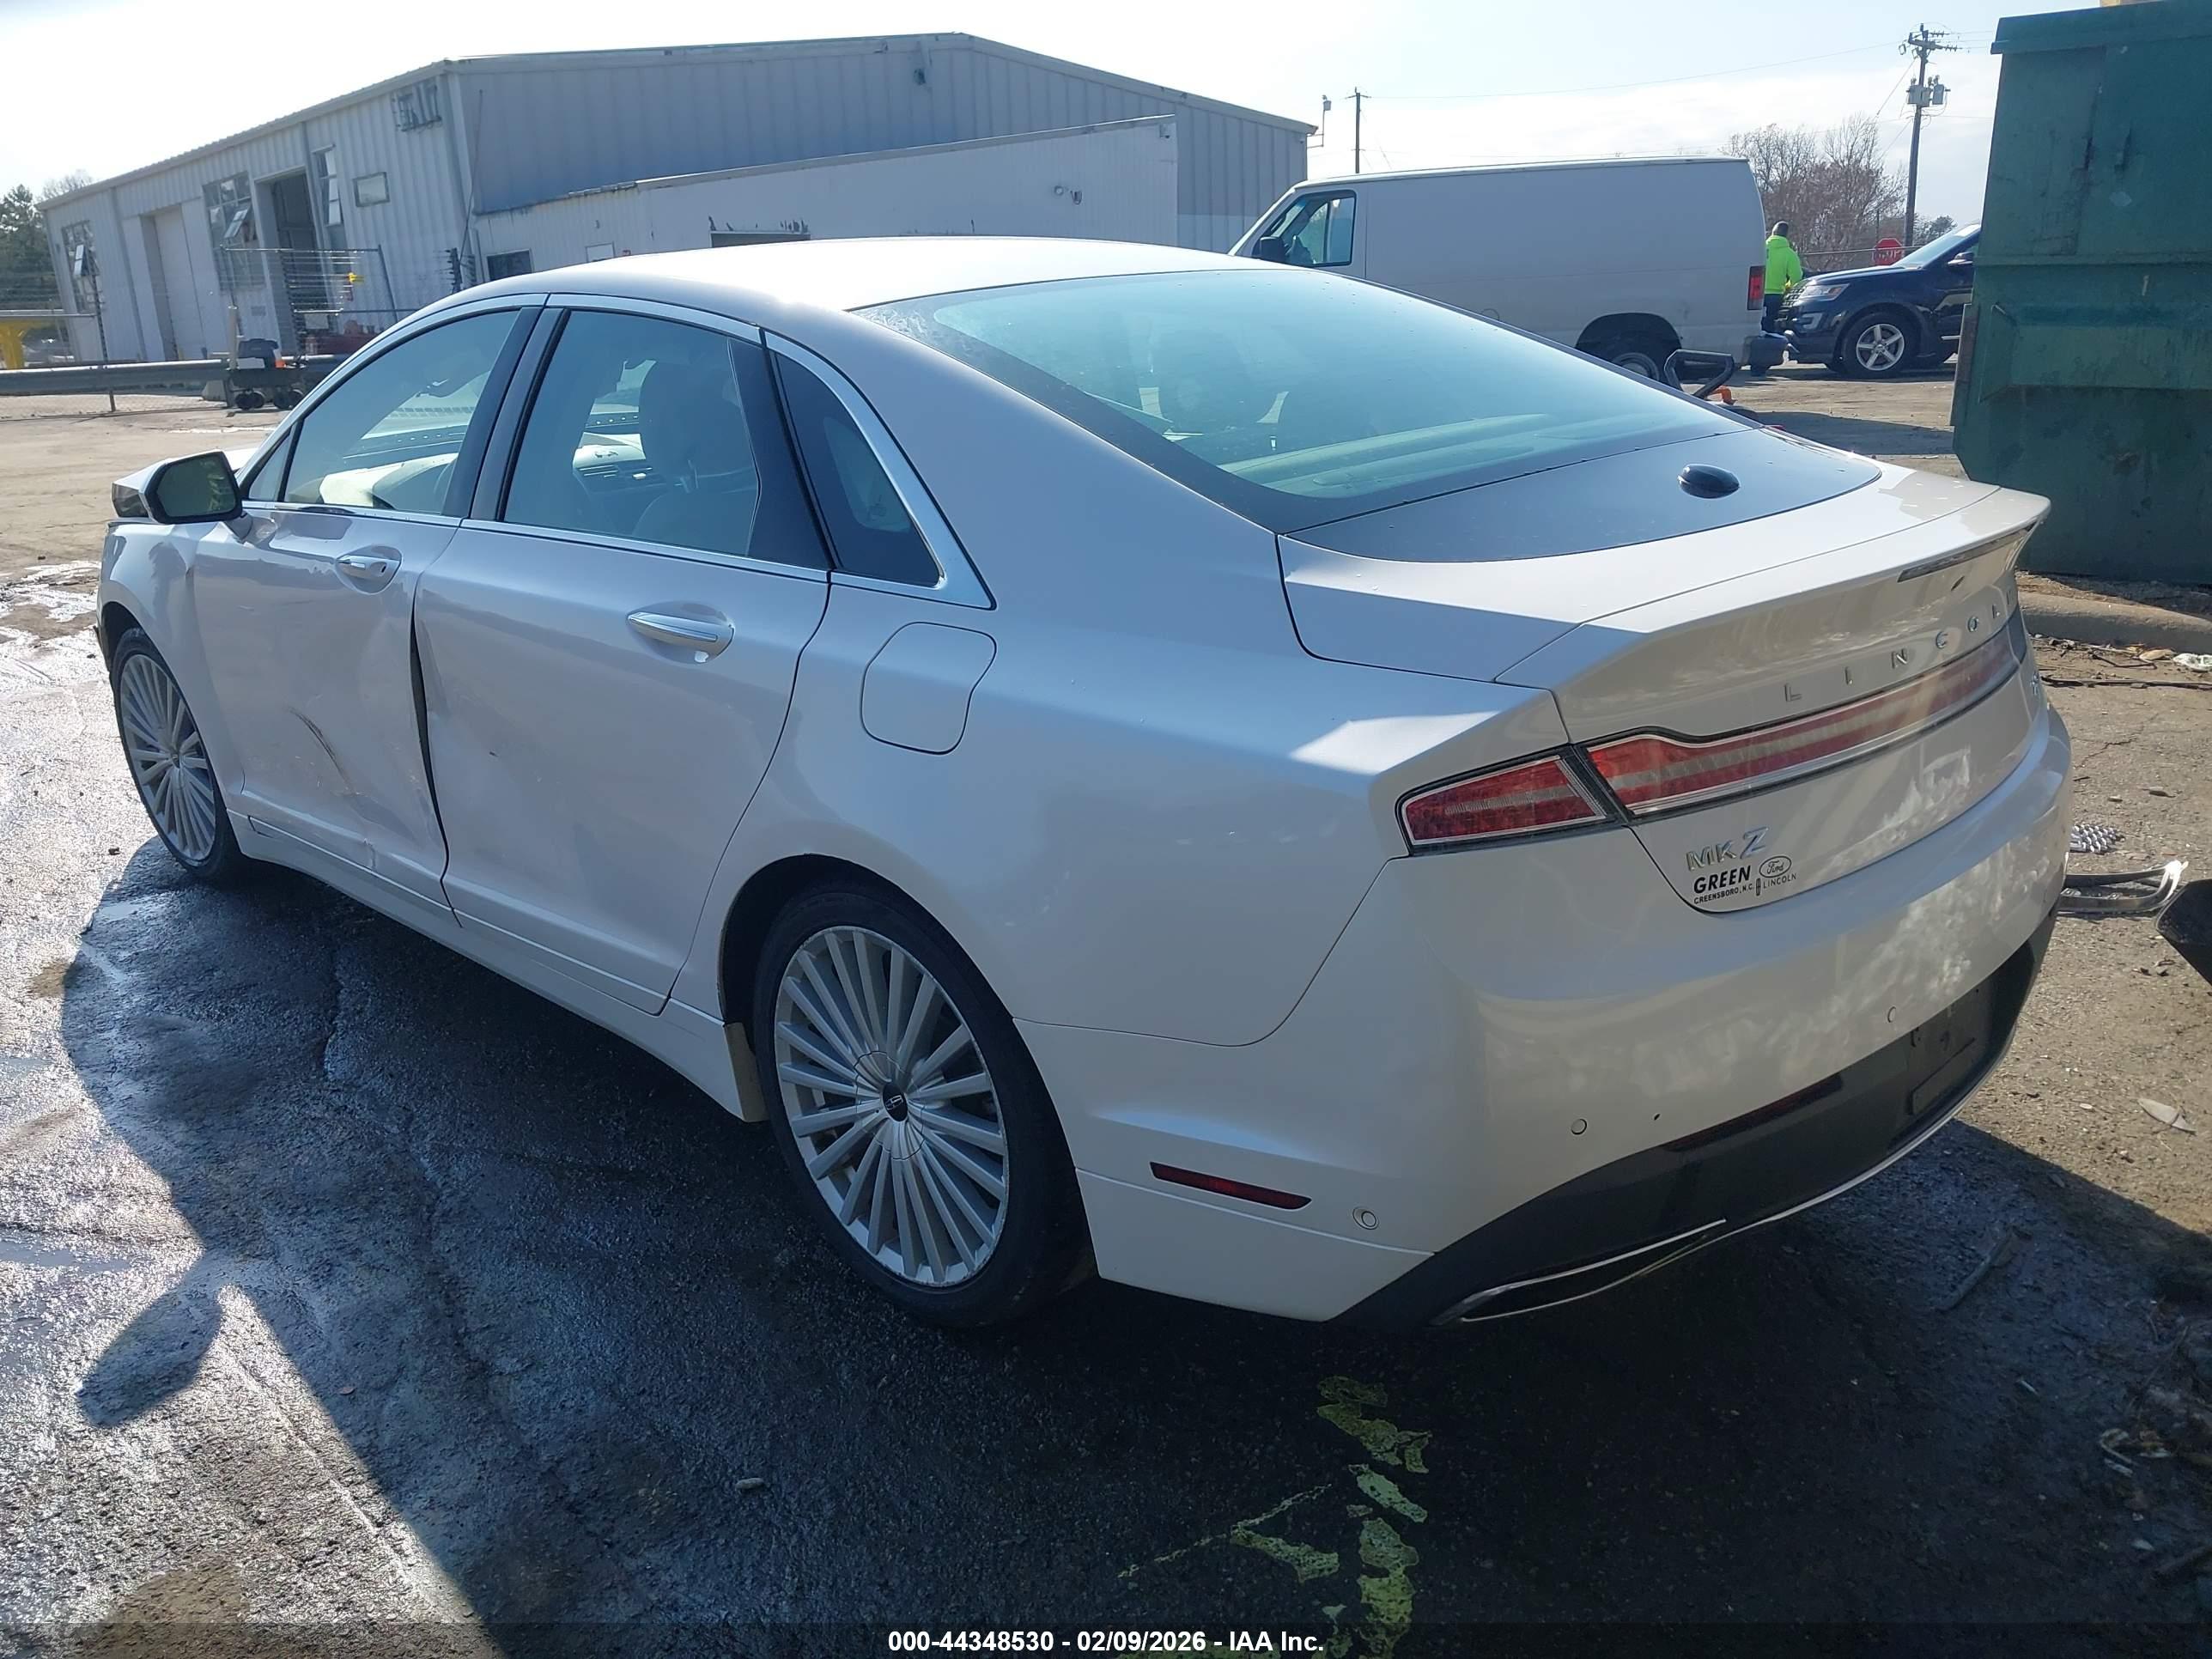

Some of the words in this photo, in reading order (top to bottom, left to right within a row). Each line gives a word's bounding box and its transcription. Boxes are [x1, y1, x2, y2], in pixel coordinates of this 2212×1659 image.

[1766, 860, 1785, 874] Ford
[1693, 865, 1751, 894] GREEN
[1763, 873, 1797, 889] LINCOLN
